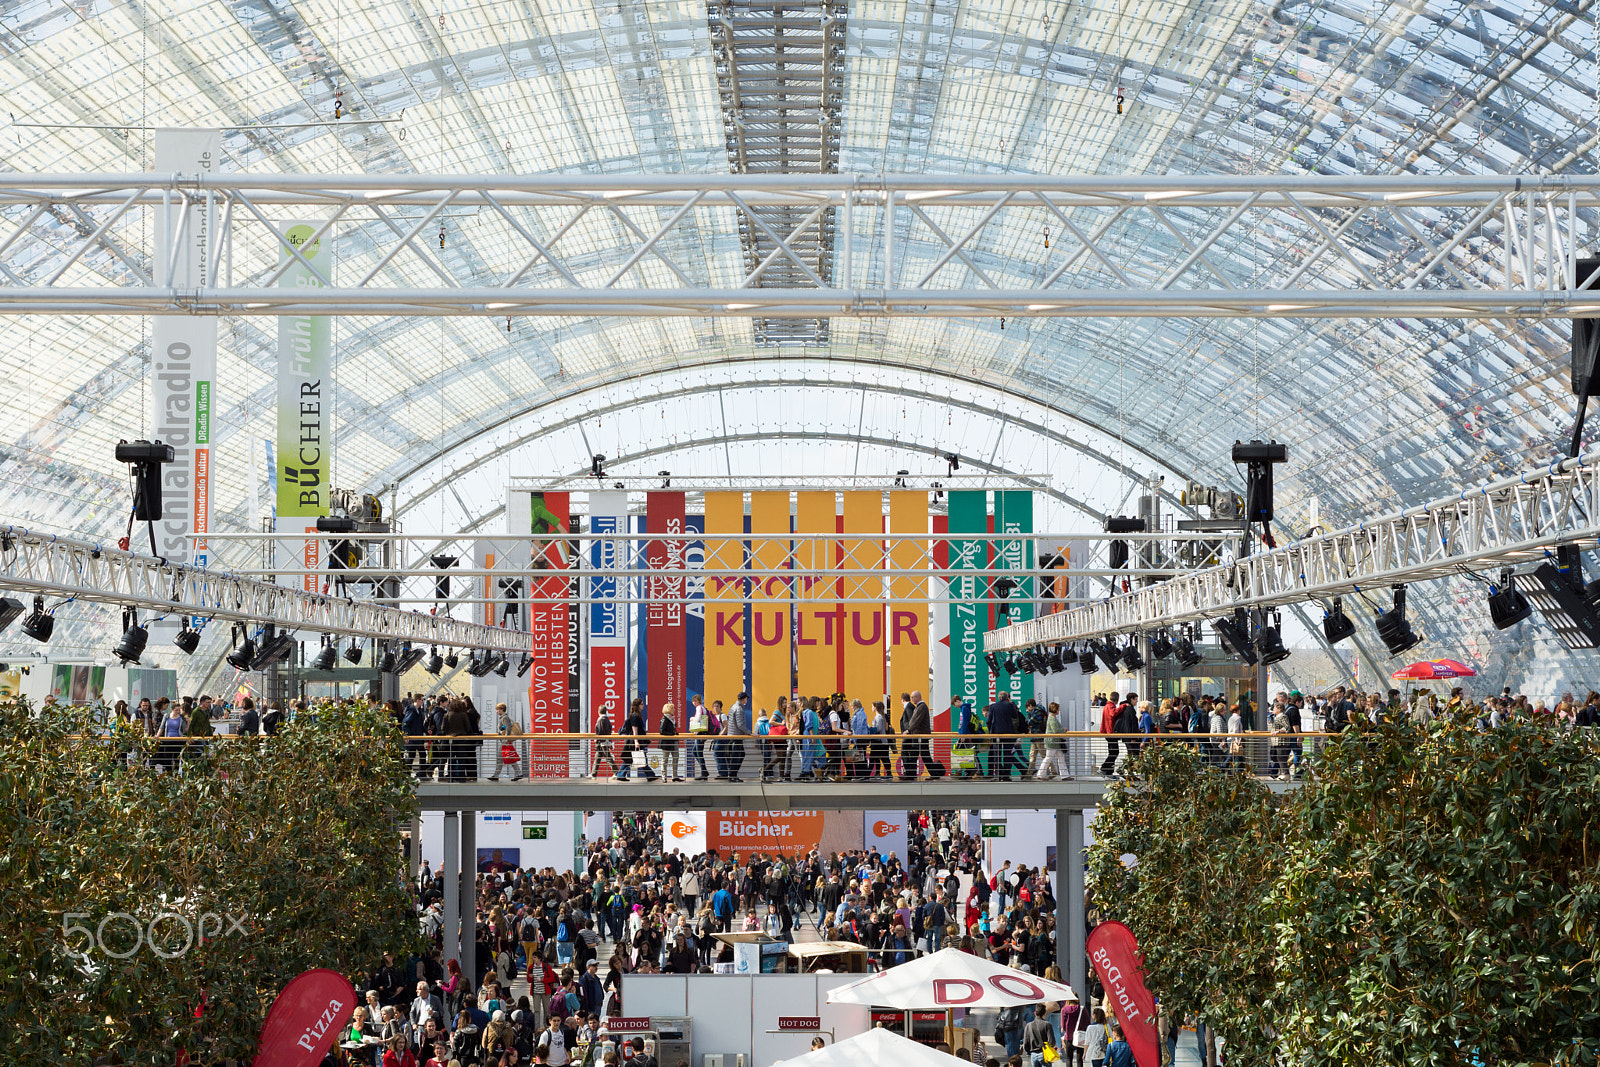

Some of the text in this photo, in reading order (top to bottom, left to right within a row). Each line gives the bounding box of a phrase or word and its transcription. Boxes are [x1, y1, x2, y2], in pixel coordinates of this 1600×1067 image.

[287, 274, 319, 378] Frühg
[197, 383, 208, 441] DRadio Wissen
[197, 451, 207, 477] Kultur
[650, 556, 663, 627] LEIPZIGR
[686, 547, 705, 620] ARD
[716, 611, 920, 647] KULTUR
[535, 611, 547, 733] UND WO LESEN
[551, 592, 564, 734] SIE AM LIEBSTEN?
[665, 651, 674, 690] begeistern
[719, 820, 794, 837] Bücher.
[296, 999, 343, 1053] Pizza
[610, 1020, 650, 1029] HOT DOG
[780, 1019, 819, 1028] HOT DOG
